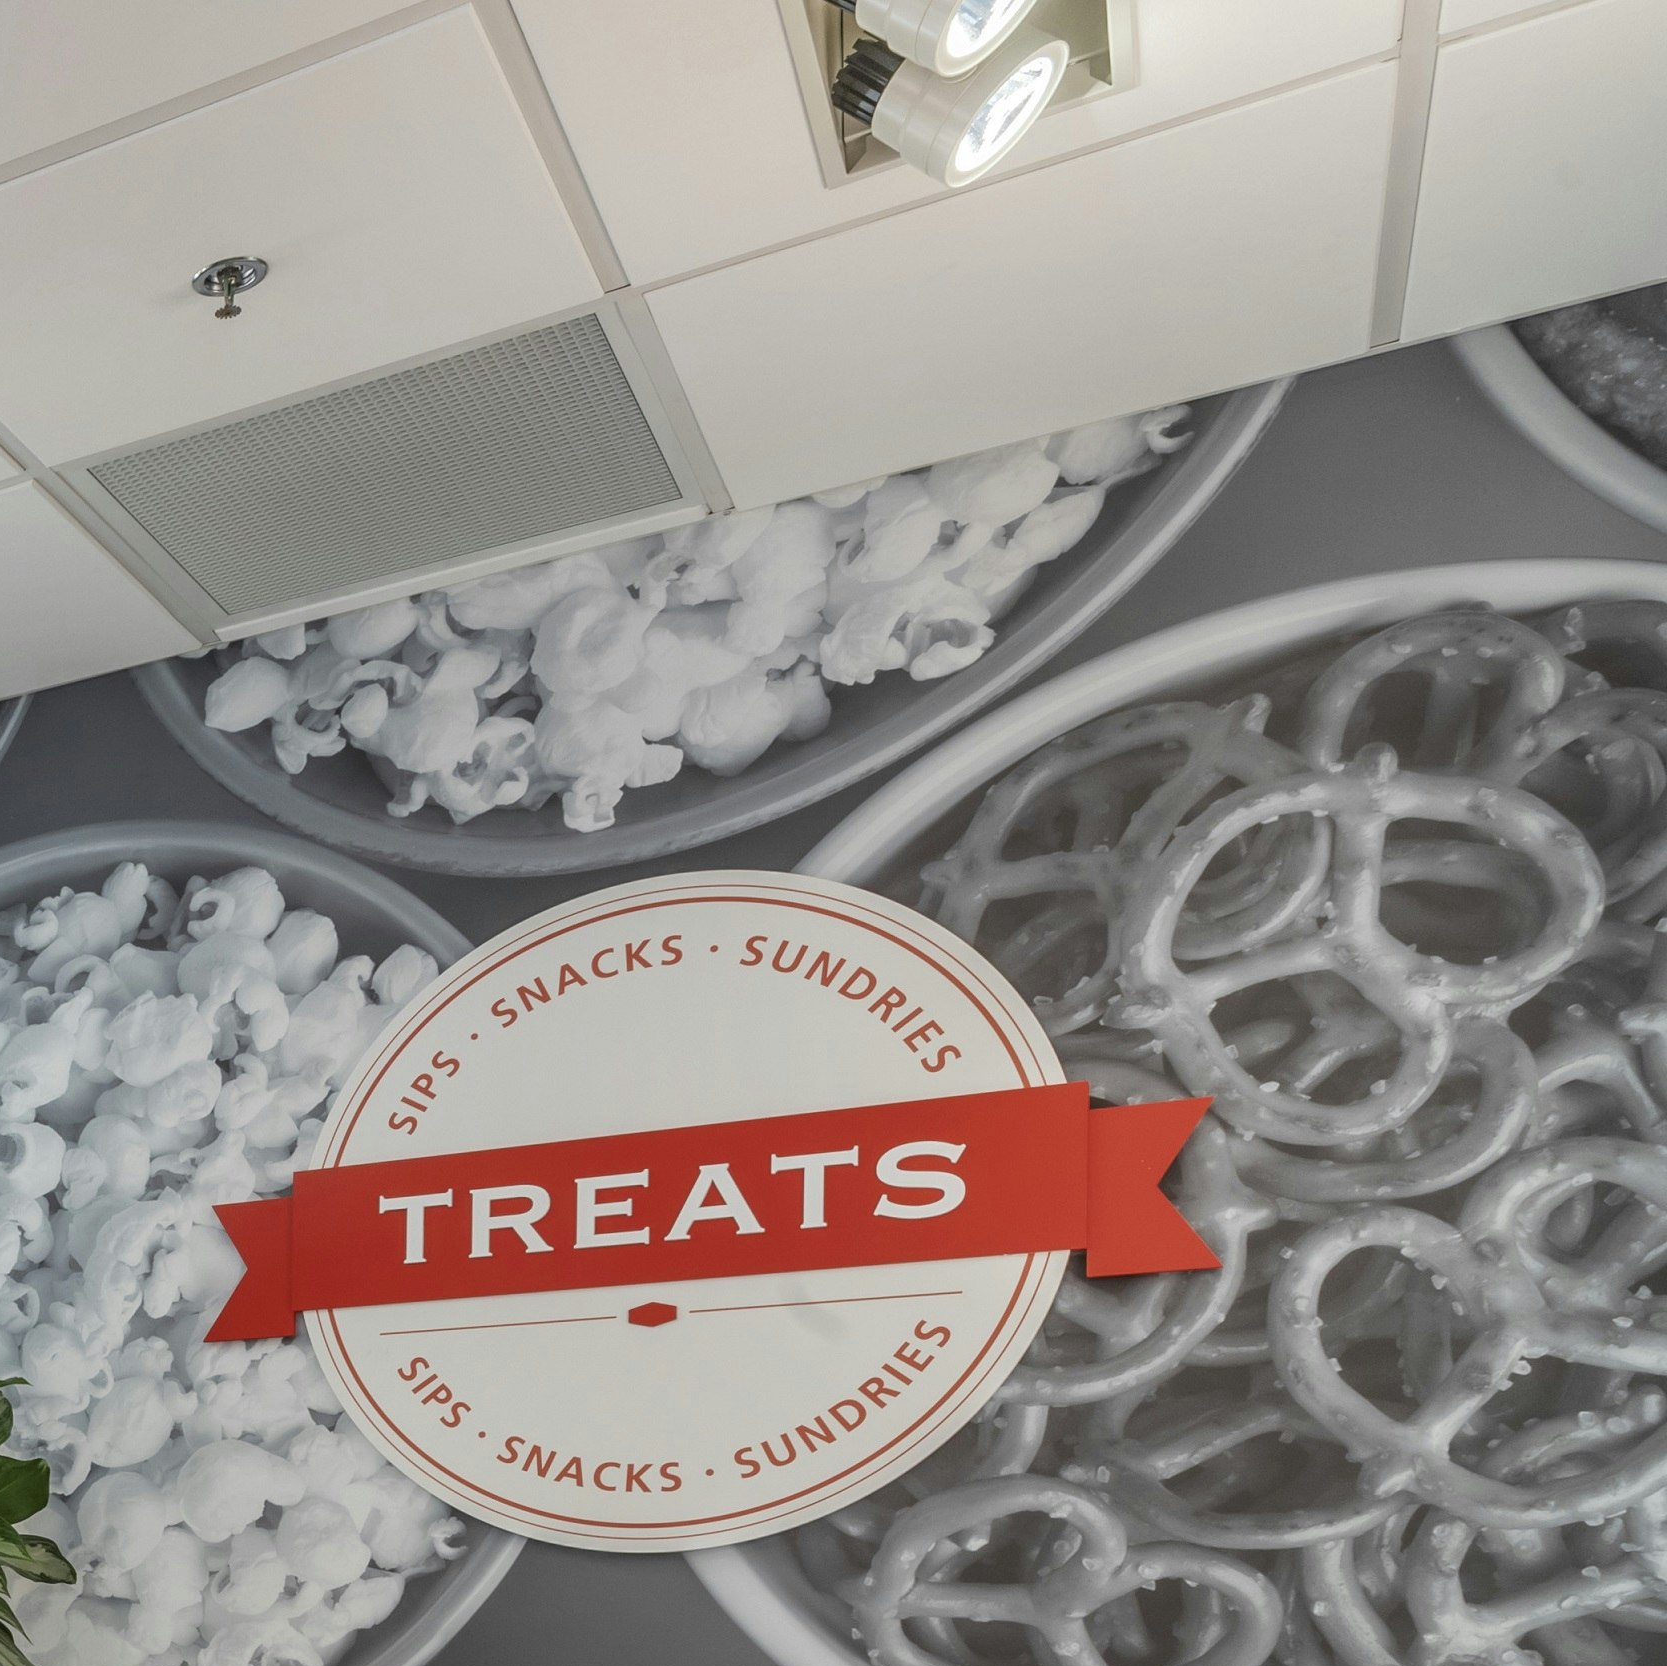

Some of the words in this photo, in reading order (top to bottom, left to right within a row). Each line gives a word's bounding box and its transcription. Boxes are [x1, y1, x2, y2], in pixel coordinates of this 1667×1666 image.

[388, 1050, 462, 1136] SIPS
[491, 934, 685, 1029] SNACKS
[740, 934, 963, 1076] SUNDRIES
[379, 1140, 969, 1265] TREATS
[397, 1355, 470, 1429] SIPS
[498, 1435, 683, 1494] SNACKS
[736, 1318, 954, 1480] SUNDRIES
